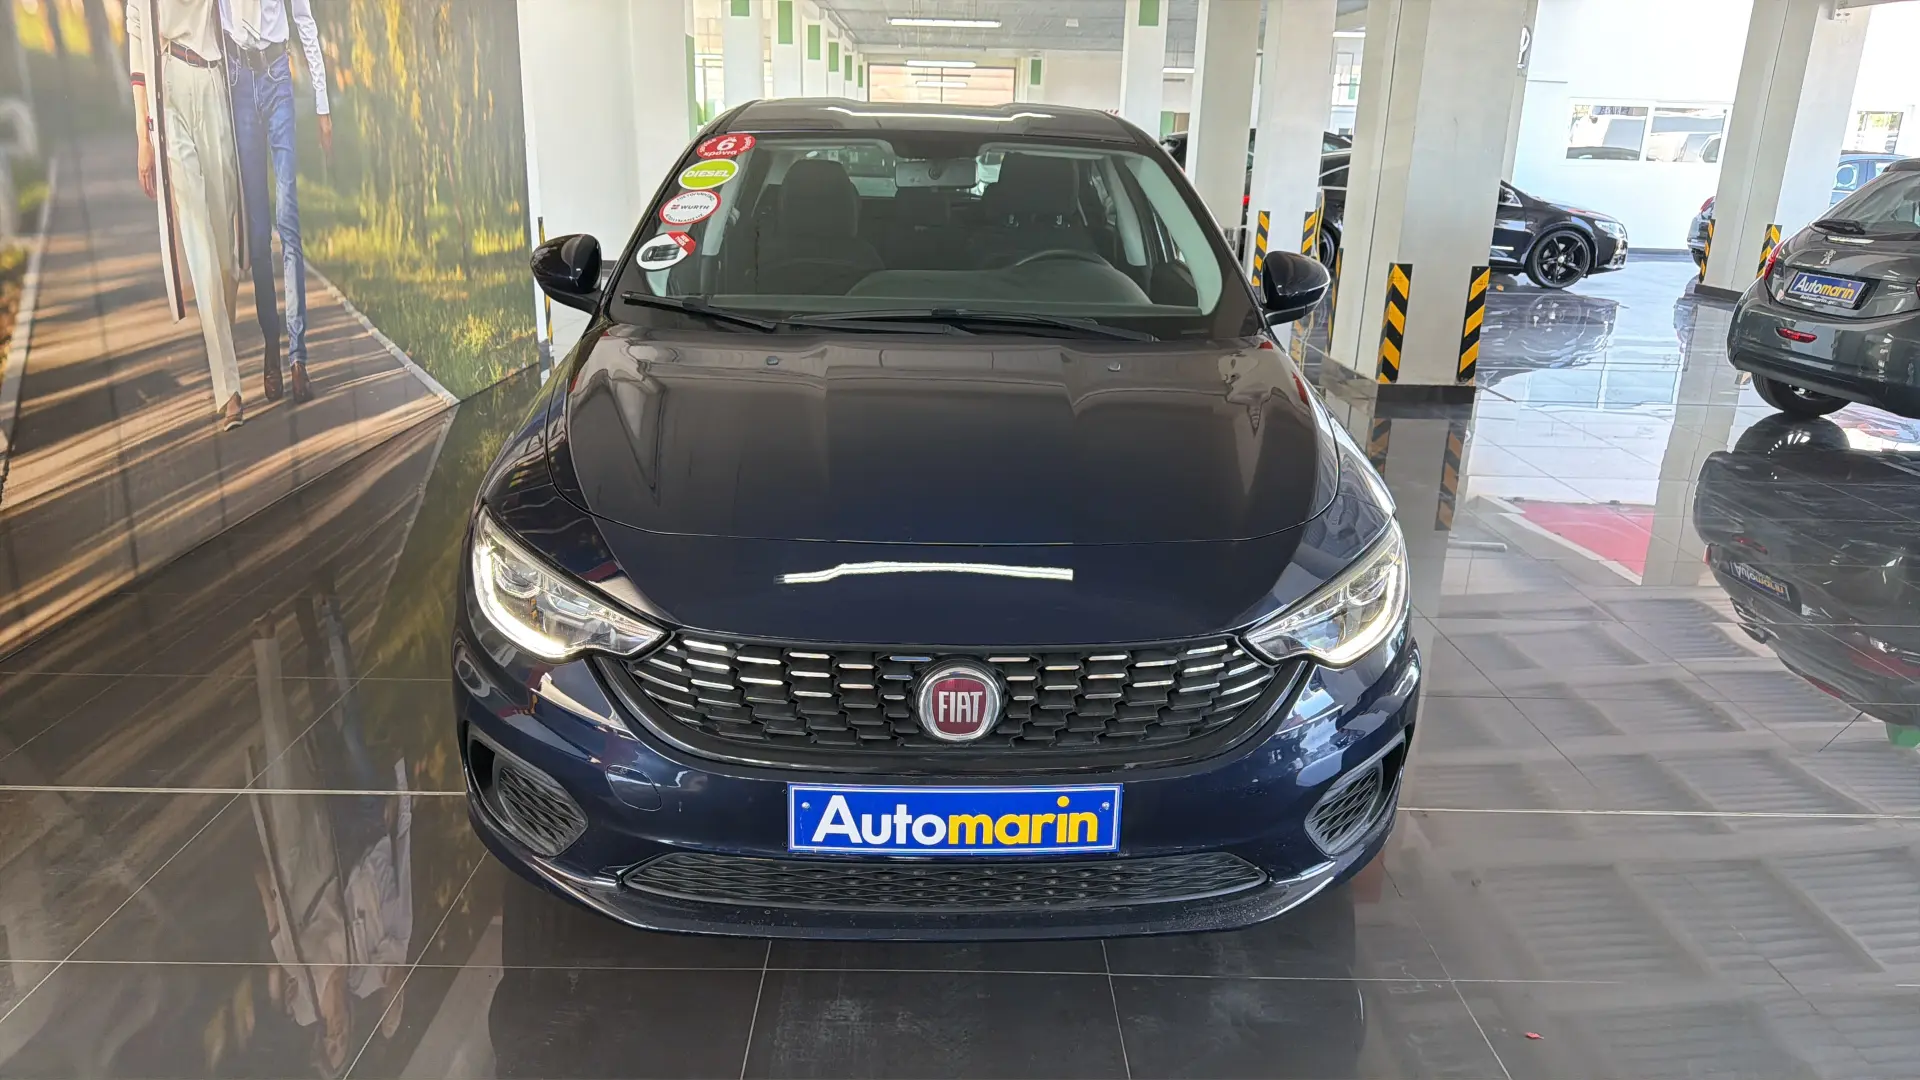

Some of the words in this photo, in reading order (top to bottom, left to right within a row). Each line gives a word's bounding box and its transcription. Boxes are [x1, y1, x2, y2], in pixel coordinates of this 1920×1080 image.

[717, 138, 738, 151] 6
[684, 169, 730, 178] DIESEL
[1794, 275, 1855, 300] Automarin
[938, 690, 983, 723] FIAT
[811, 794, 1099, 846] Automarin
